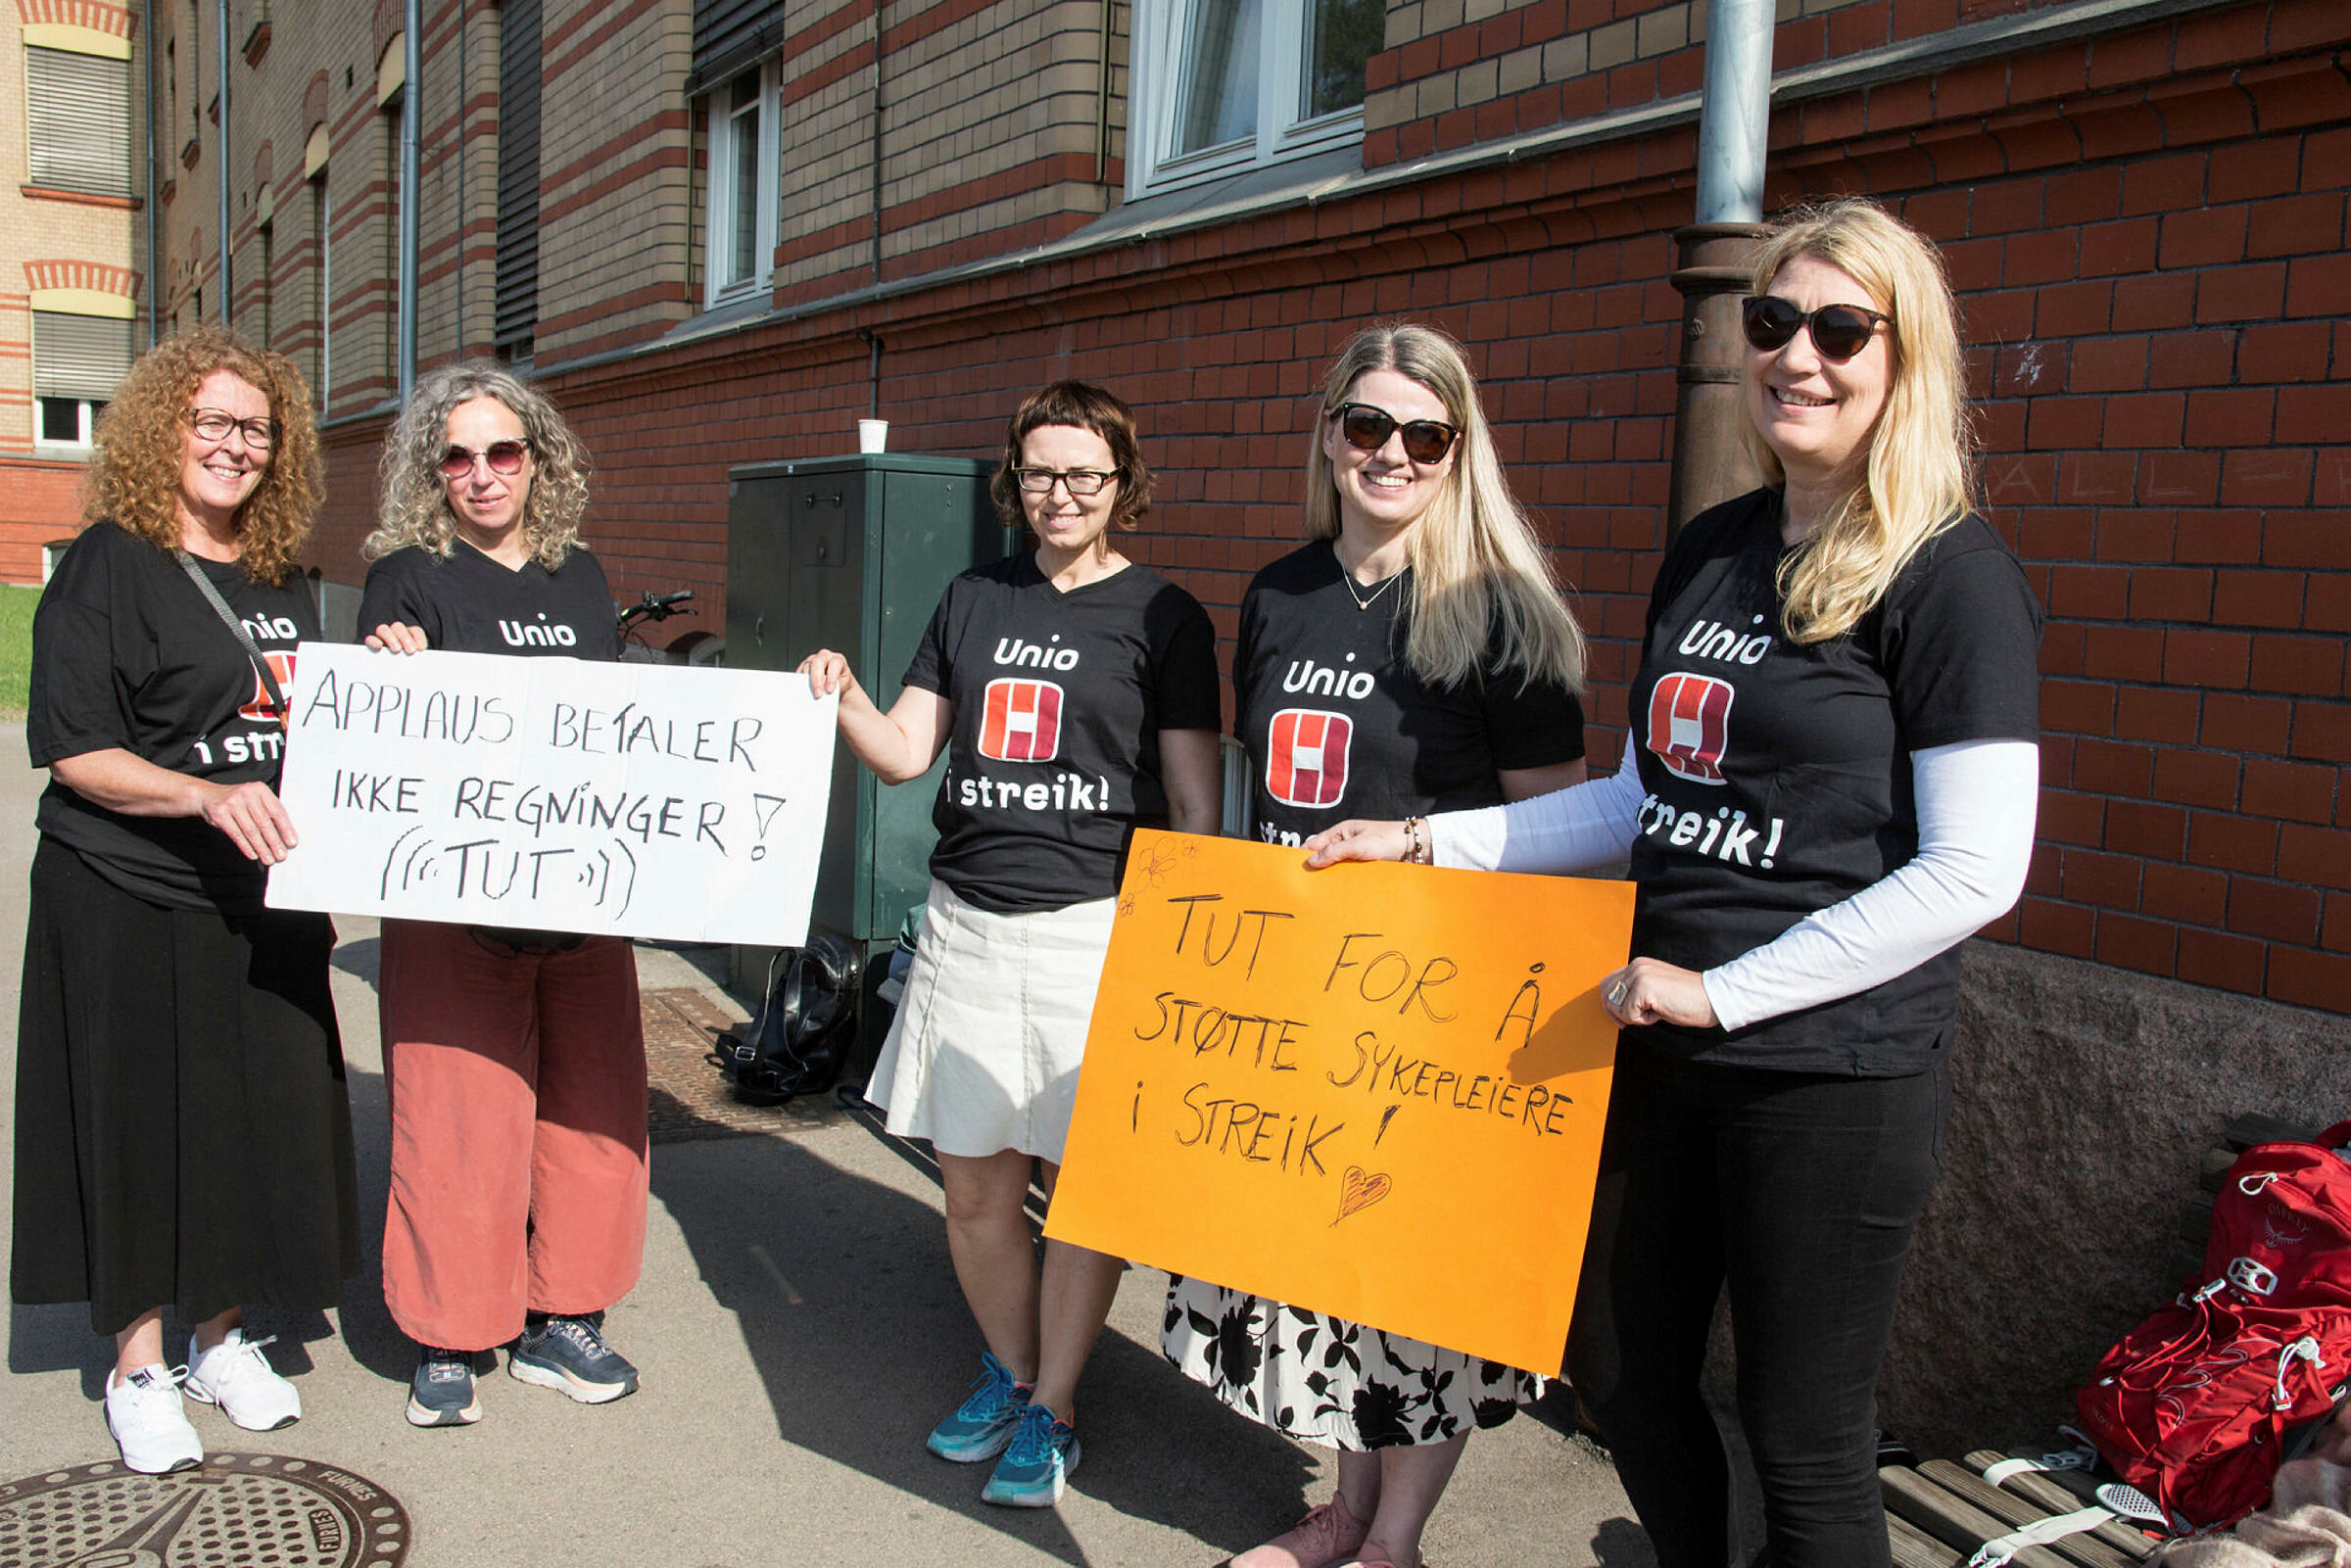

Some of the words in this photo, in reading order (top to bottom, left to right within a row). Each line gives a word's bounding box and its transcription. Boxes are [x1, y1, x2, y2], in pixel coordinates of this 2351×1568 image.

[241, 612, 298, 640] nio
[498, 612, 577, 646] Unio
[1678, 614, 1772, 665] Unio
[993, 634, 1080, 671] Unio
[1282, 651, 1375, 699] Unio
[302, 668, 514, 744] APPLAUS
[550, 702, 763, 772] BETALER
[333, 769, 427, 814] IKKE
[960, 773, 1110, 811] streik!
[1637, 793, 1784, 869] treik!
[1168, 893, 1296, 982] TUT
[1324, 932, 1459, 1023] FOR
[1495, 962, 1547, 1049] Å
[1134, 991, 1310, 1071] STØTTE
[316, 1470, 377, 1501] FURNES
[310, 1509, 340, 1550] FURNES
